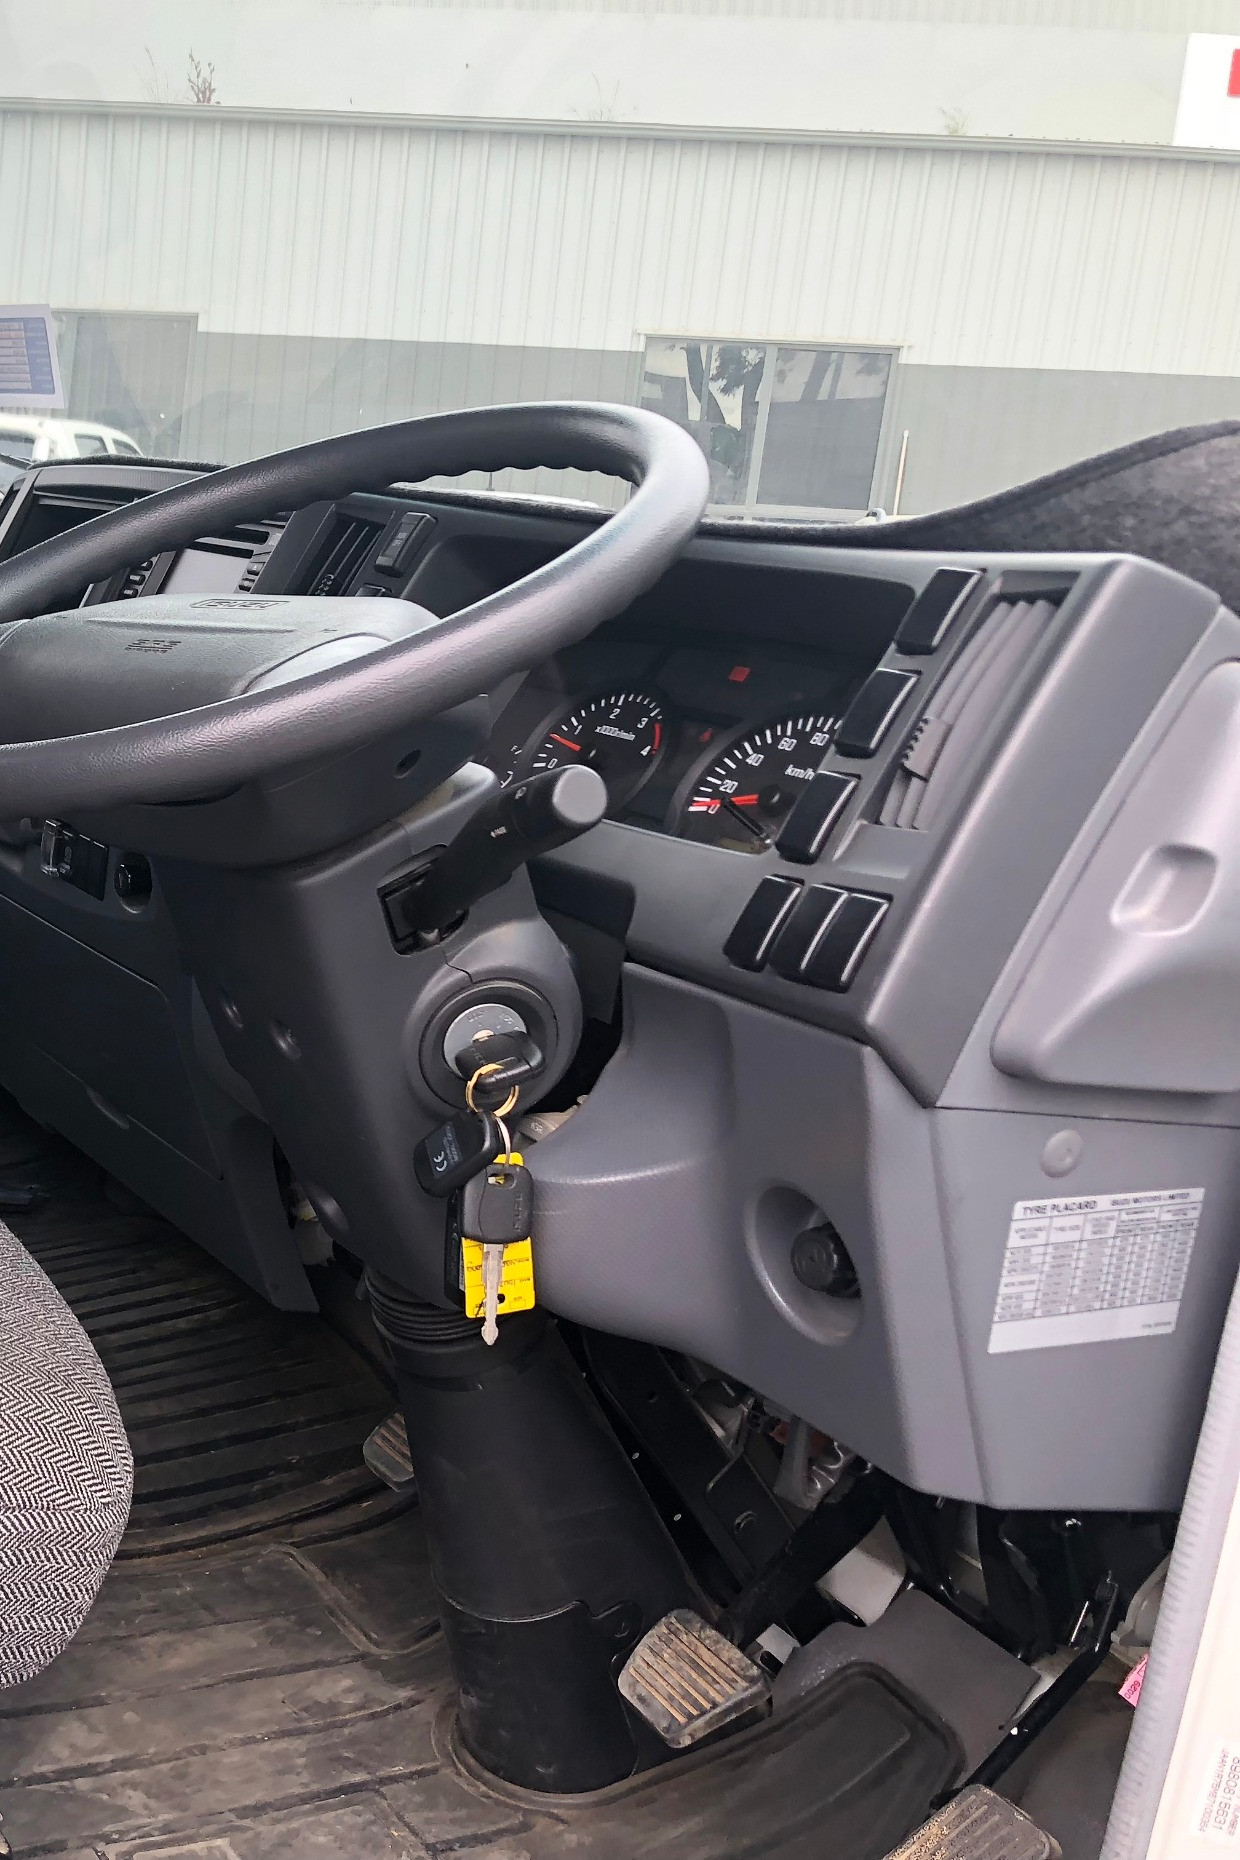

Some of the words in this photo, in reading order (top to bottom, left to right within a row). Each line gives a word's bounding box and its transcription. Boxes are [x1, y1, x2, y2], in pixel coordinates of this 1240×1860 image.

[609, 708, 620, 719] 2
[637, 717, 648, 728] 3
[778, 738, 797, 751] 60
[810, 733, 830, 746] 80
[639, 746, 650, 757] 4
[547, 758, 556, 768] 0
[746, 753, 763, 767] 40
[784, 764, 815, 780] km/h
[720, 780, 738, 793] 20
[708, 804, 719, 814] 0
[1022, 1203, 1048, 1215] TYRE
[1050, 1200, 1098, 1213] PLACARD
[1124, 1680, 1141, 1699] 0029
